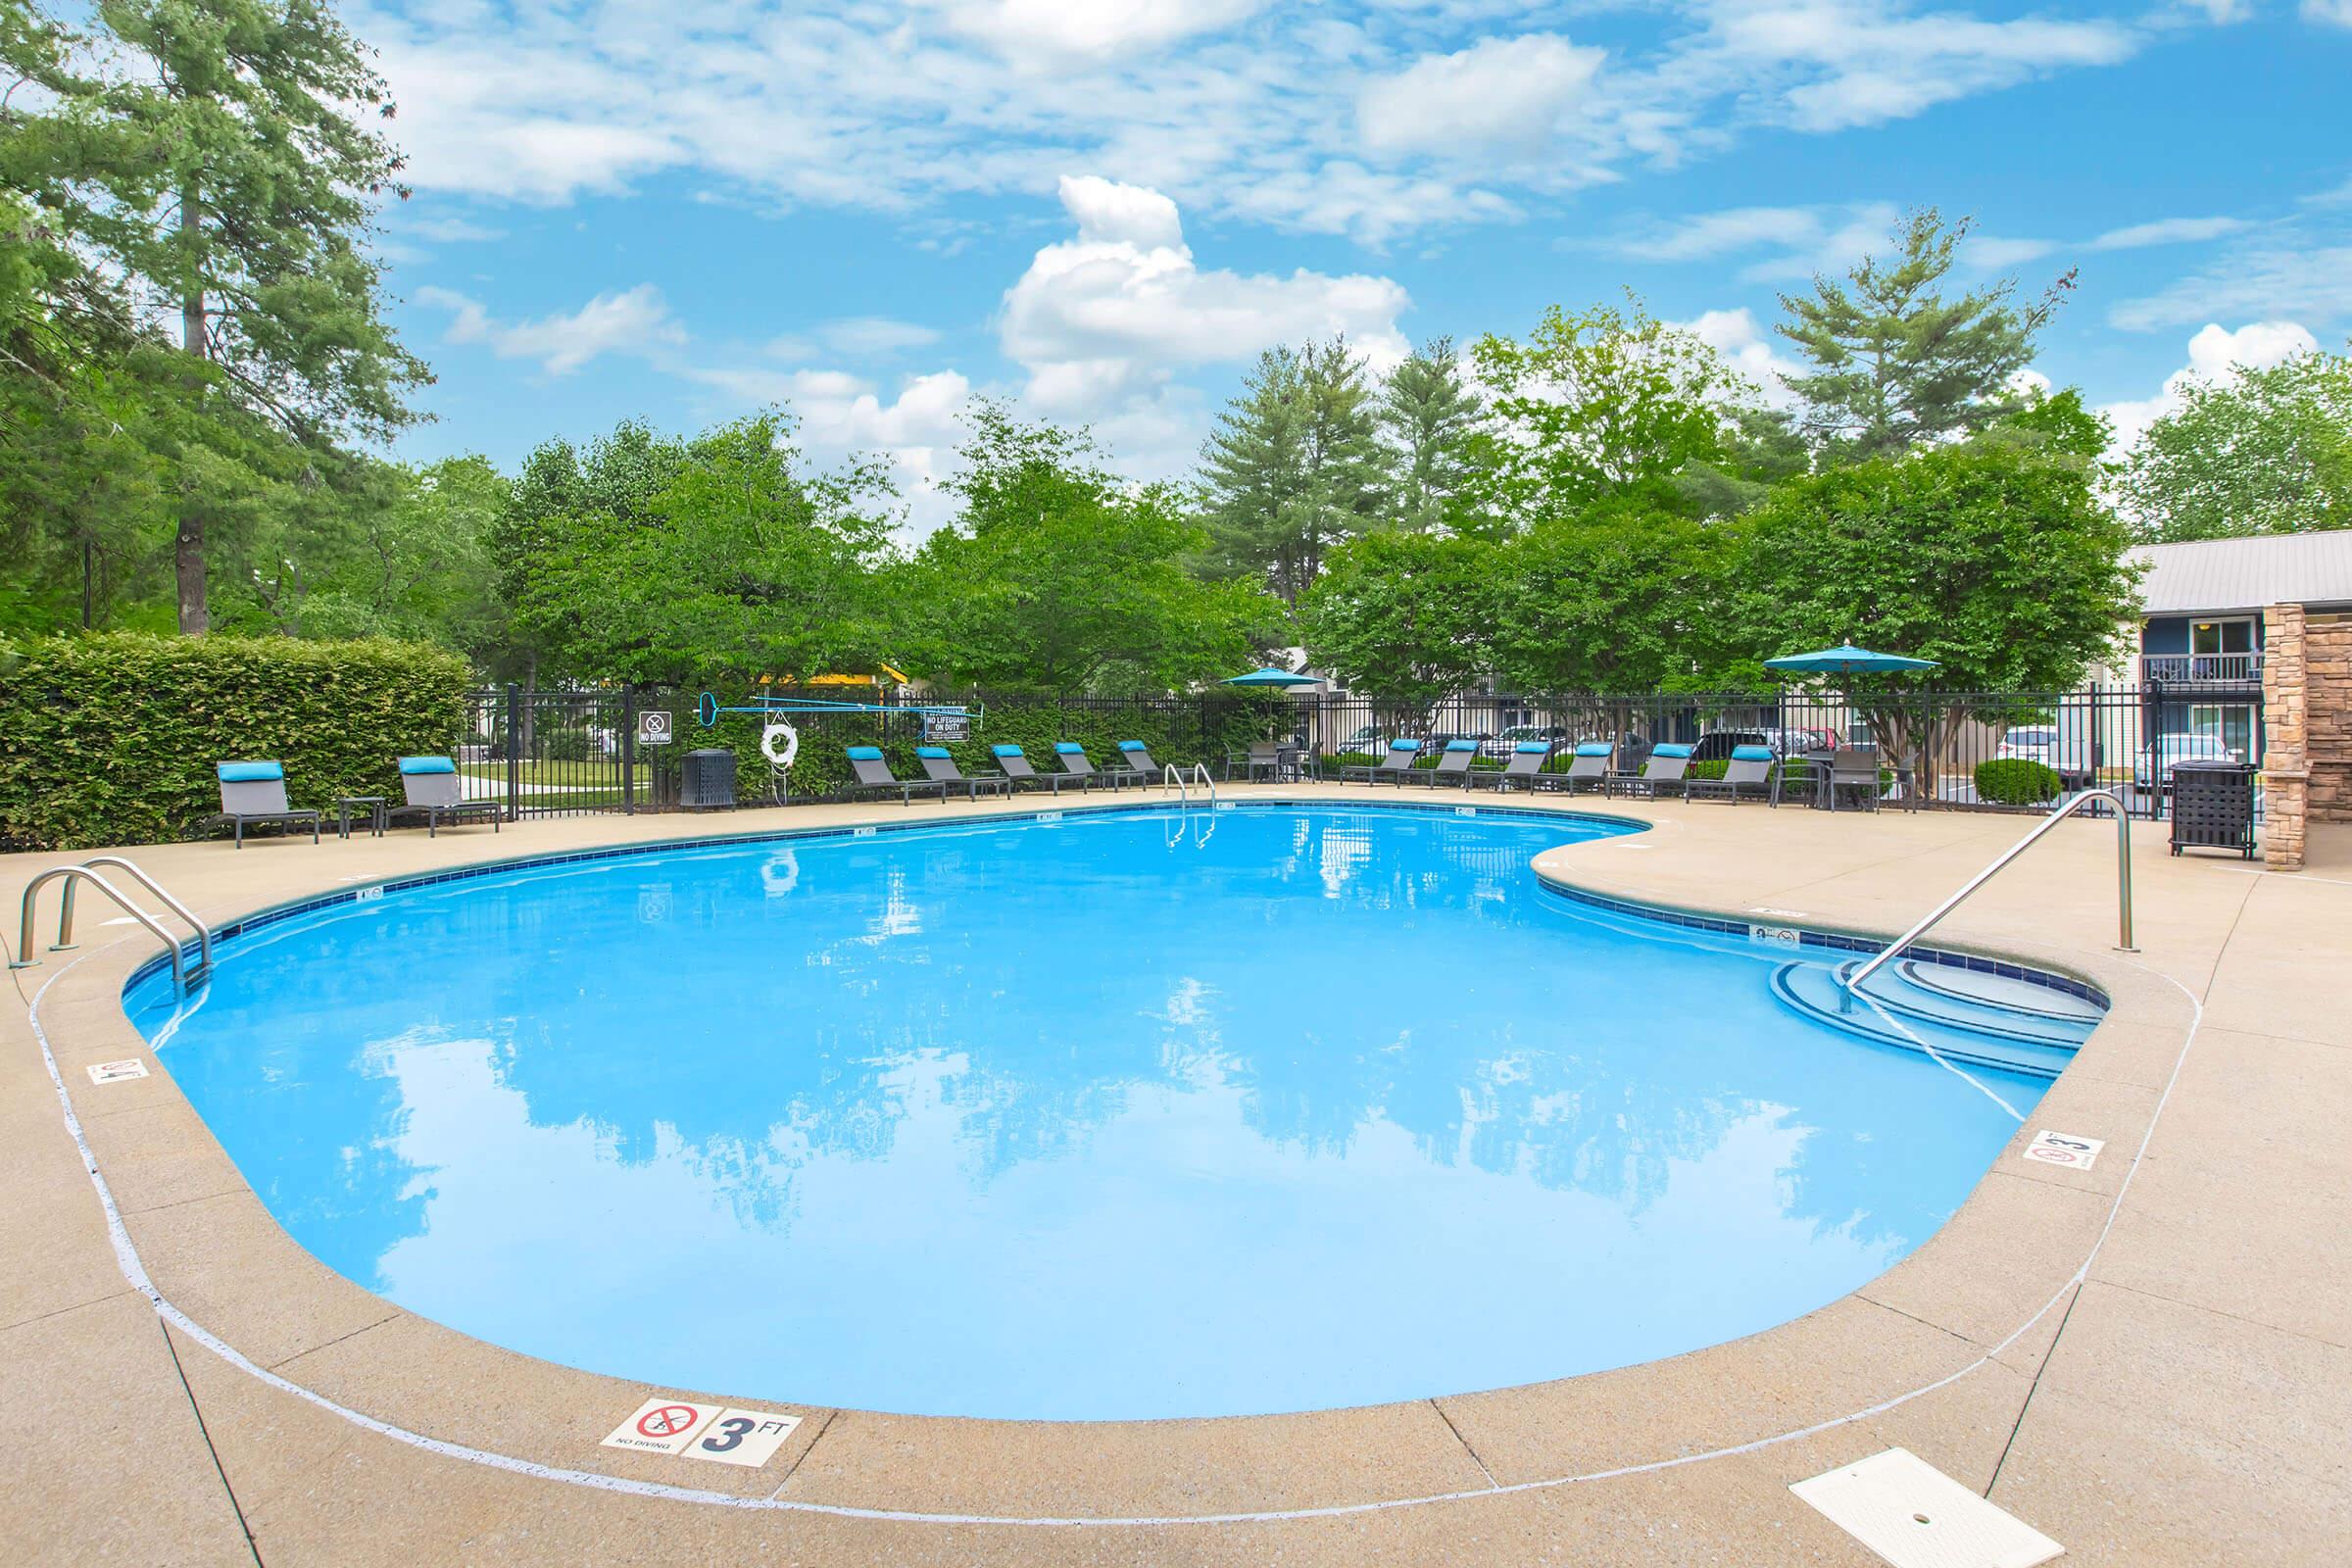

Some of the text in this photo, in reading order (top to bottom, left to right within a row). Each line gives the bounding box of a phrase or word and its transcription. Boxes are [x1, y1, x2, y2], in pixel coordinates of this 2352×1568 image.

[640, 732, 670, 742] NO DIVING
[701, 1417, 790, 1452] 3 FT
[615, 1437, 671, 1450] NO DIVING
